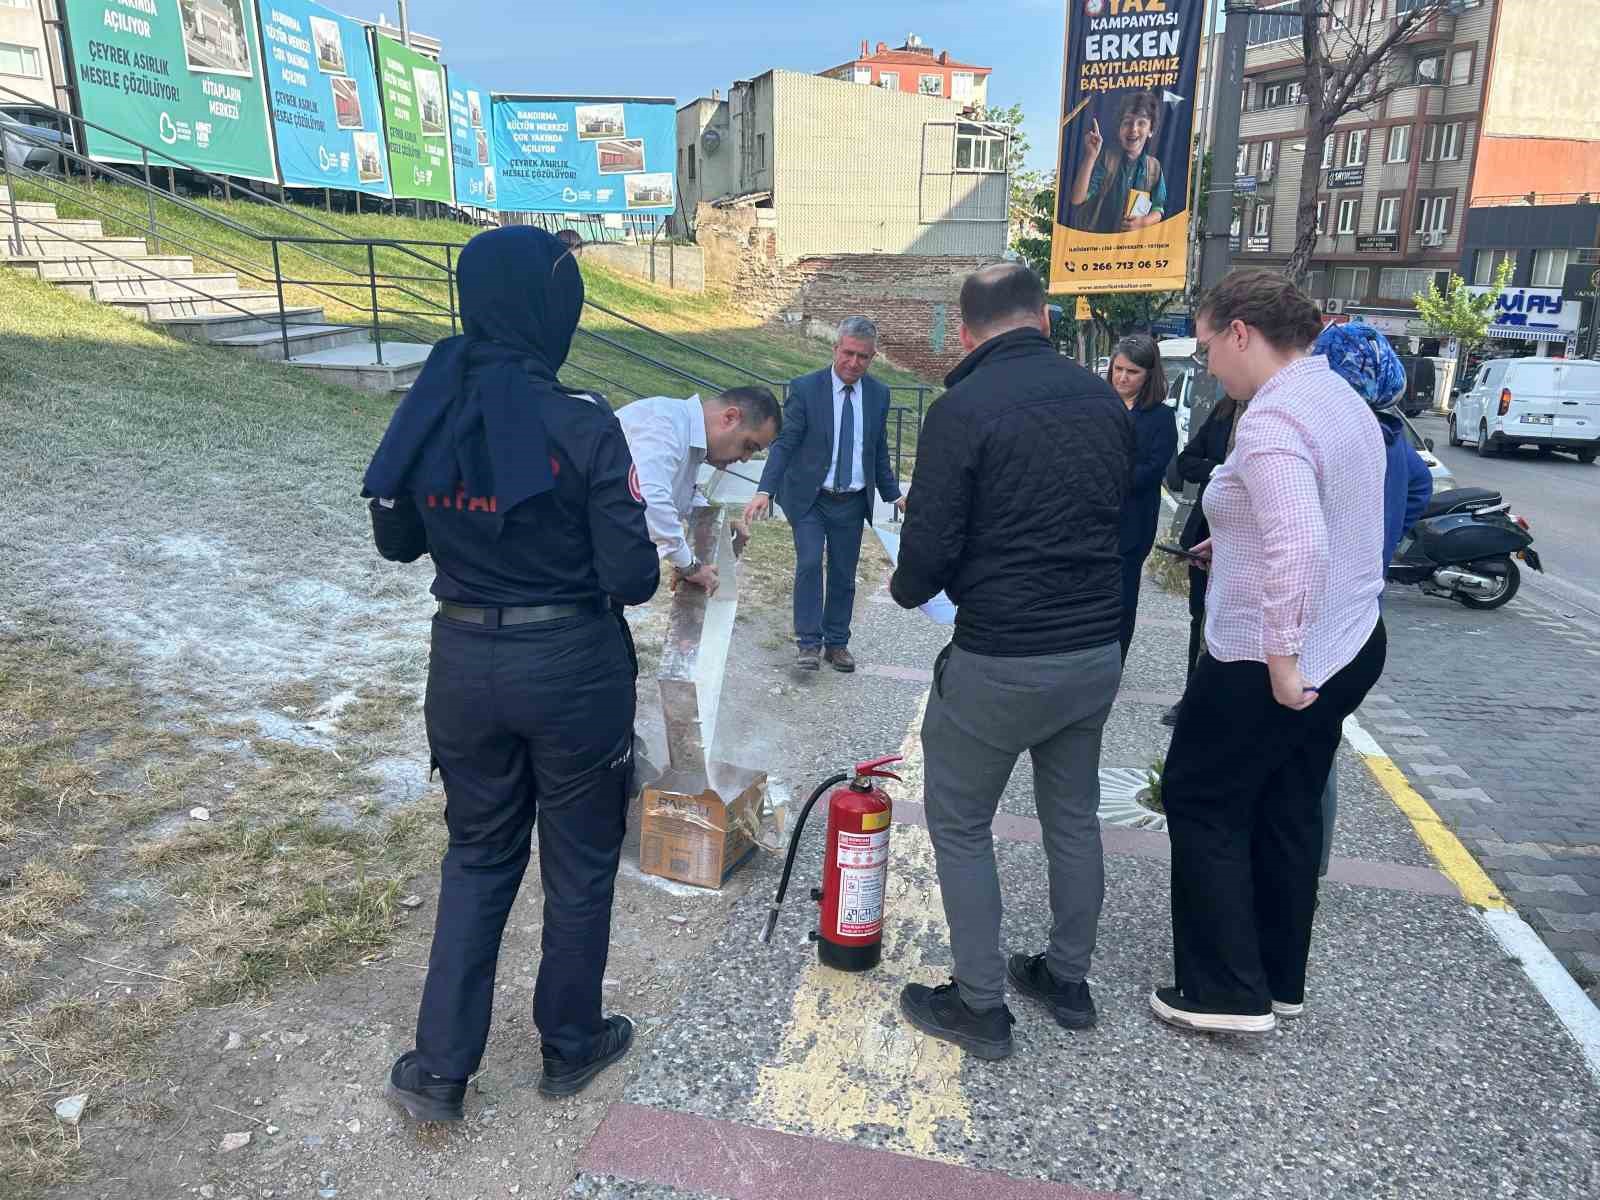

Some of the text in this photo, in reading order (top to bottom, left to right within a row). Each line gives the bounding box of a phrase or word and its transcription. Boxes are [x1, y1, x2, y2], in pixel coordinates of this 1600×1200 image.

[104, 9, 151, 38] AÇILIYOR
[1091, 12, 1178, 31] KAMPANYASI
[1085, 30, 1180, 61] ERKEN
[89, 40, 169, 76] ÇEYREK ASIRLIK
[1081, 57, 1180, 76] KAYITLARIMIZ
[80, 64, 180, 102] MESELE ÇÖZÜLÜYOR!
[1080, 73, 1177, 93] BAŞLAMIŞTIR!
[1082, 260, 1168, 271] 0 266 713 06 57
